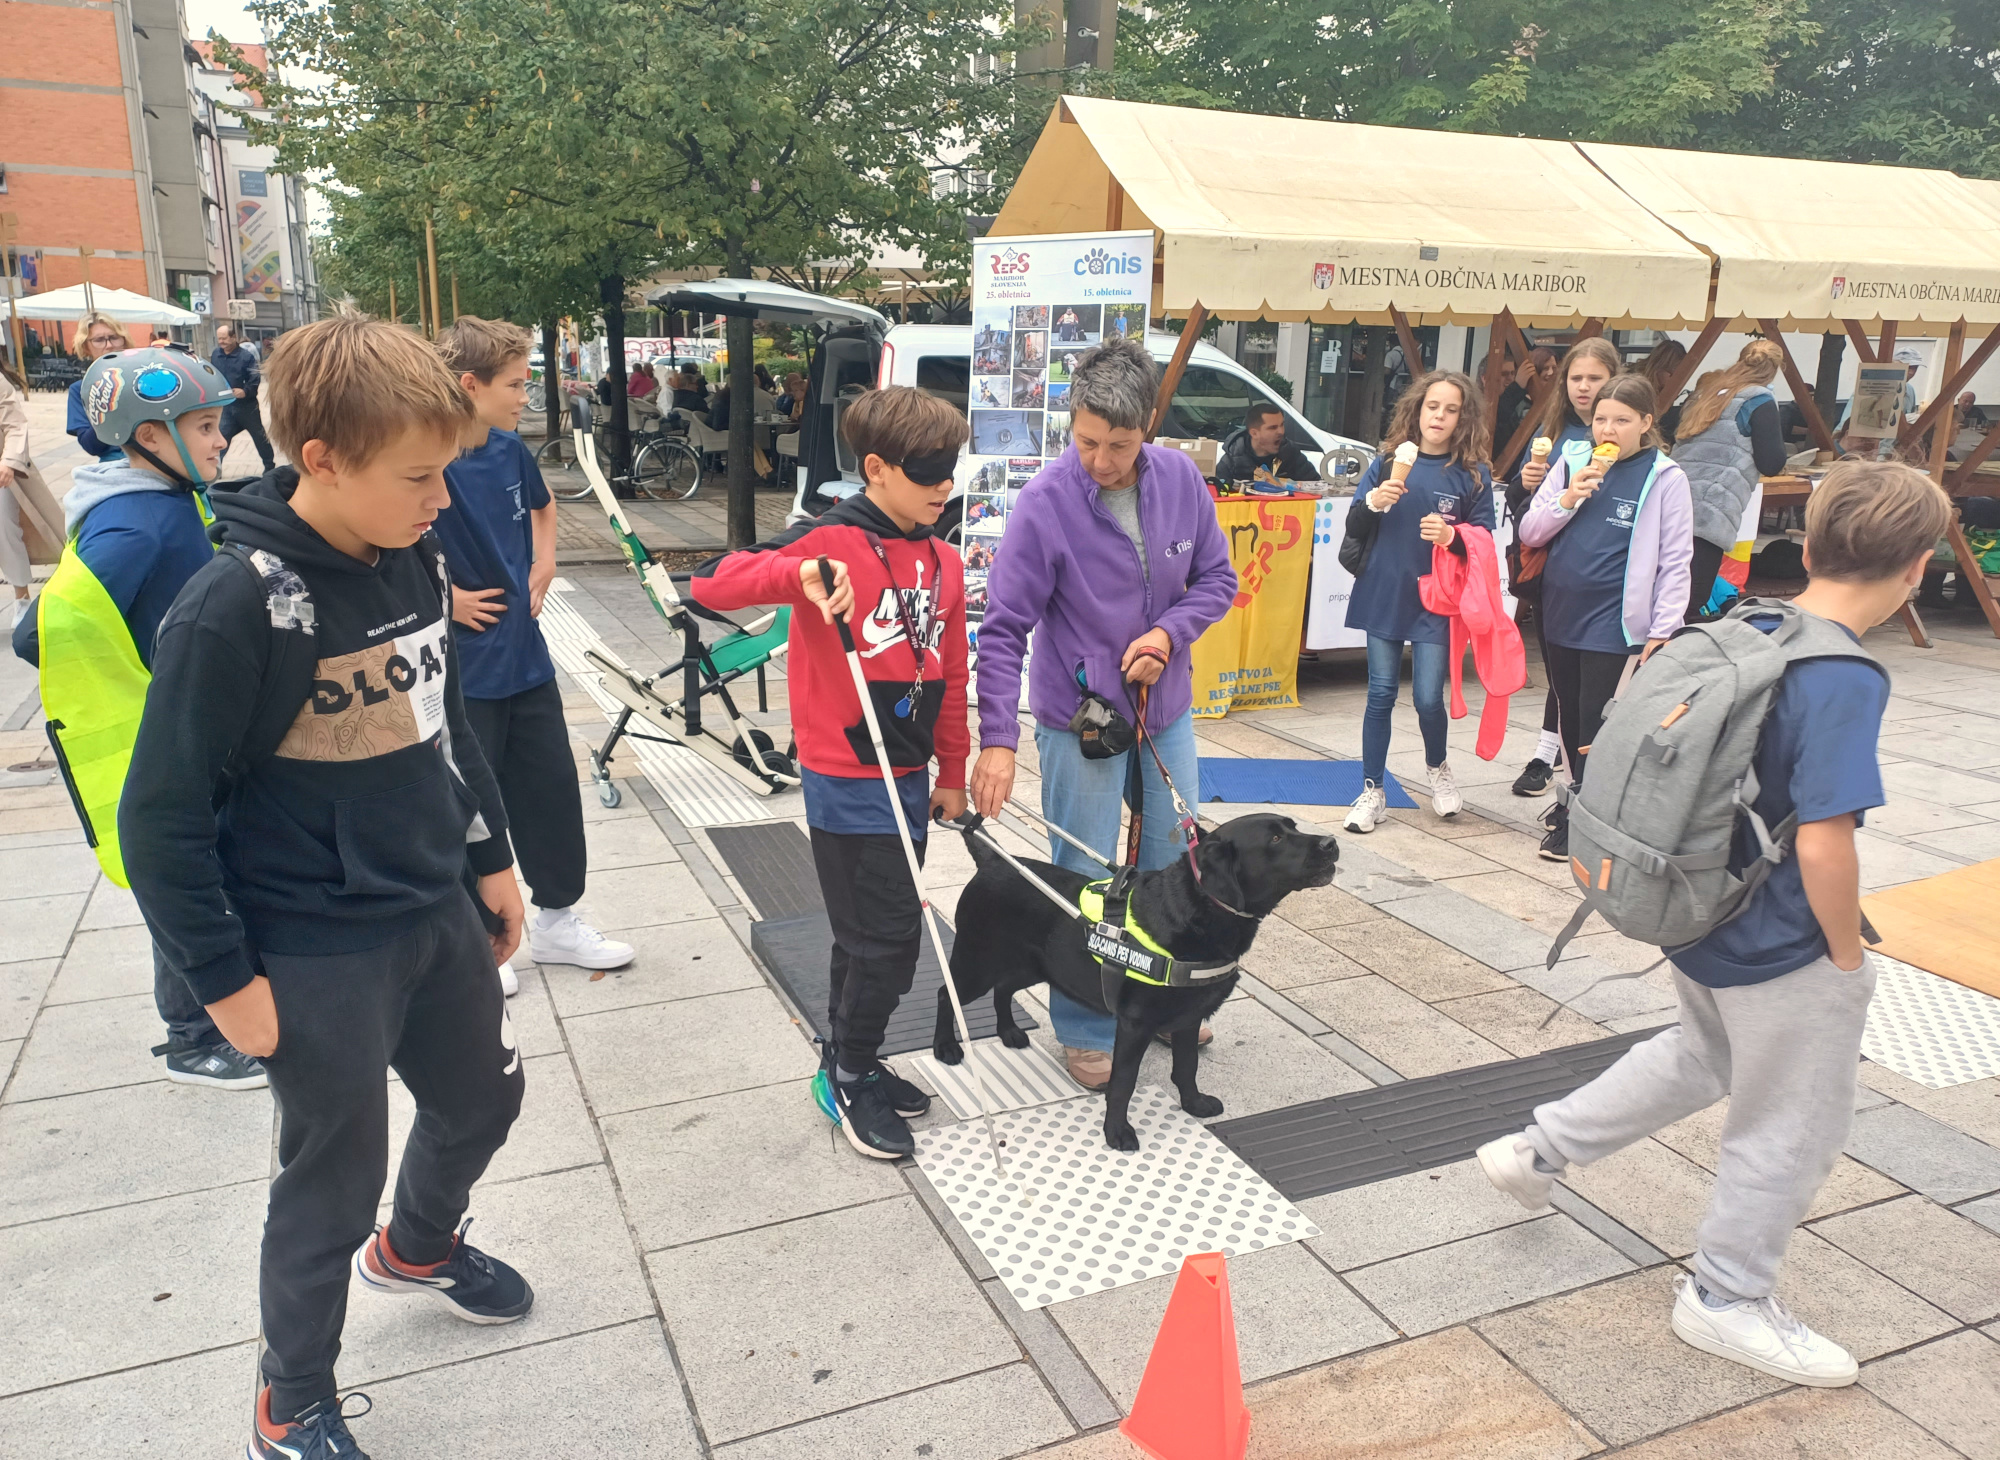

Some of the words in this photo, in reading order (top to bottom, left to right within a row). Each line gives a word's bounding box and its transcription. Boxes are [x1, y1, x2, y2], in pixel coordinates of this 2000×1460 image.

[1073, 252, 1142, 276] canis
[1338, 267, 1420, 287] MESTNA
[1424, 266, 1497, 290] OBČINA
[1501, 272, 1587, 294] MARIBOR
[986, 291, 997, 299] 25.
[997, 290, 1031, 299] obletnica
[1083, 288, 1094, 297] 15.
[1096, 287, 1132, 297] obletnica
[1847, 282, 1907, 299] MESTNA
[1909, 280, 1960, 301] OBČINA
[1165, 539, 1193, 558] canis
[1329, 592, 1350, 603] pripo
[1262, 667, 1273, 677] ZA
[1263, 681, 1281, 692] PSE
[1088, 933, 1118, 957] SLO-CANIS
[1116, 945, 1130, 962] PES
[1128, 949, 1154, 972] VODNIK
